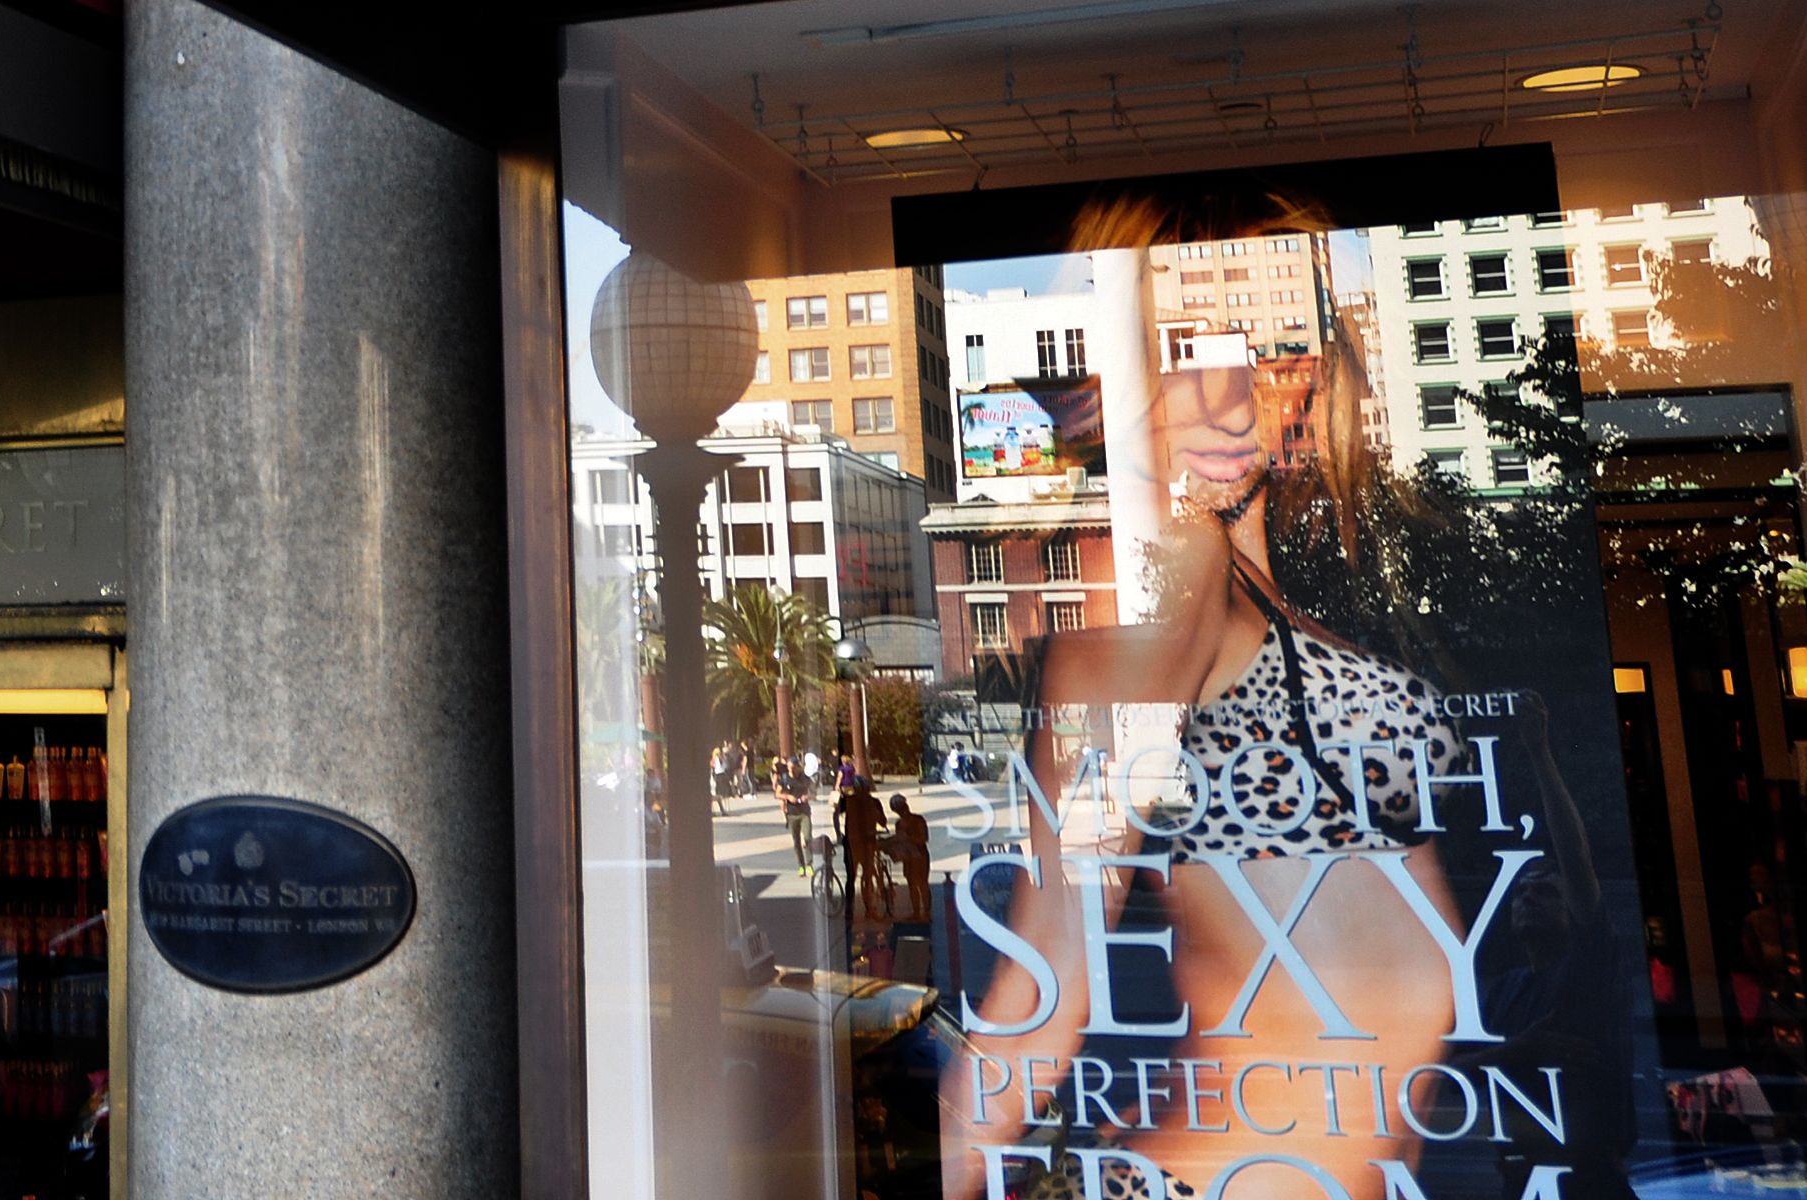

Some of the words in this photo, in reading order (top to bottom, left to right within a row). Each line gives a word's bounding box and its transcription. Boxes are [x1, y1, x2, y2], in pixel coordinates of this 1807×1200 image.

[1248, 697, 1403, 724] VITORIAS
[943, 735, 1535, 841] SMOOTH,
[146, 873, 271, 910] VICTORIA'S
[278, 879, 399, 910] SECRET
[954, 850, 1544, 1042] SEXY
[967, 1055, 1567, 1145] PERFECTION
